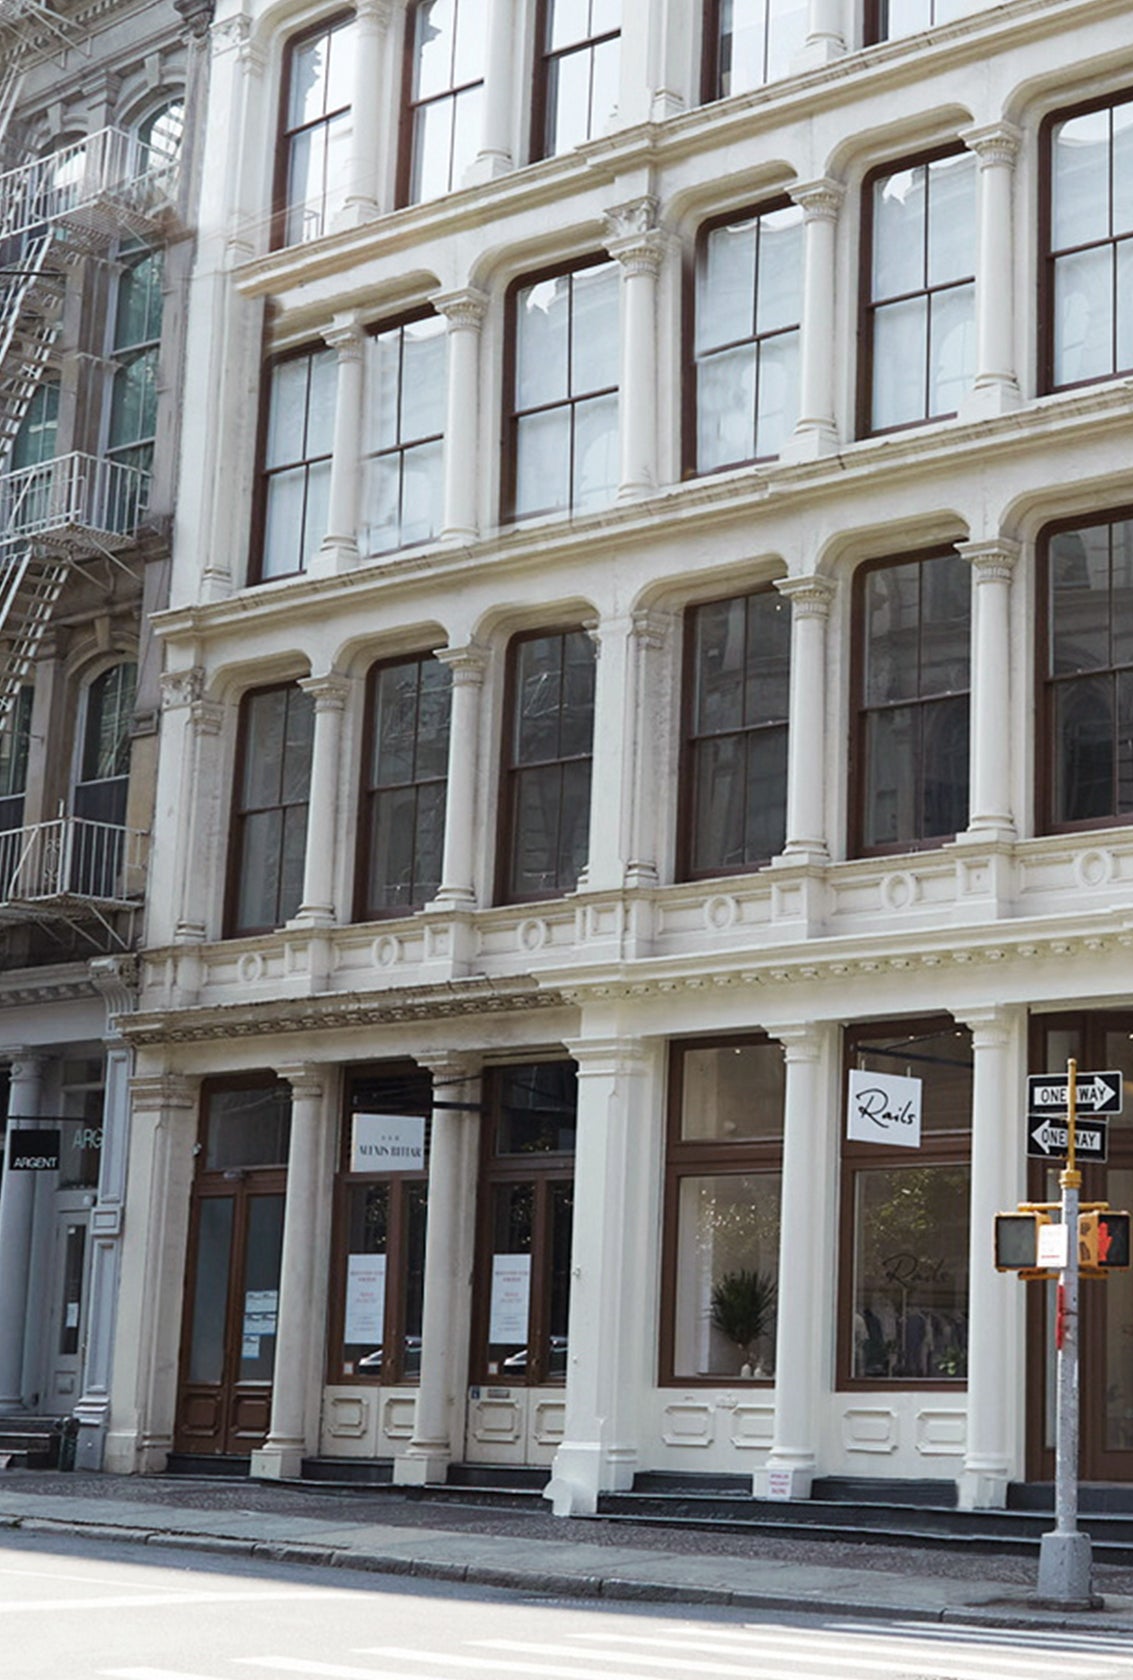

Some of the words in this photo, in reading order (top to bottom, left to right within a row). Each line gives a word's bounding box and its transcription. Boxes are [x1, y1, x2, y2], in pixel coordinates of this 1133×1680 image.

[1041, 1088, 1067, 1103] ONE
[1079, 1086, 1107, 1102] WAY
[855, 1087, 916, 1129] Rails
[1042, 1128, 1066, 1145] ONE
[13, 1156, 58, 1169] ARGENT
